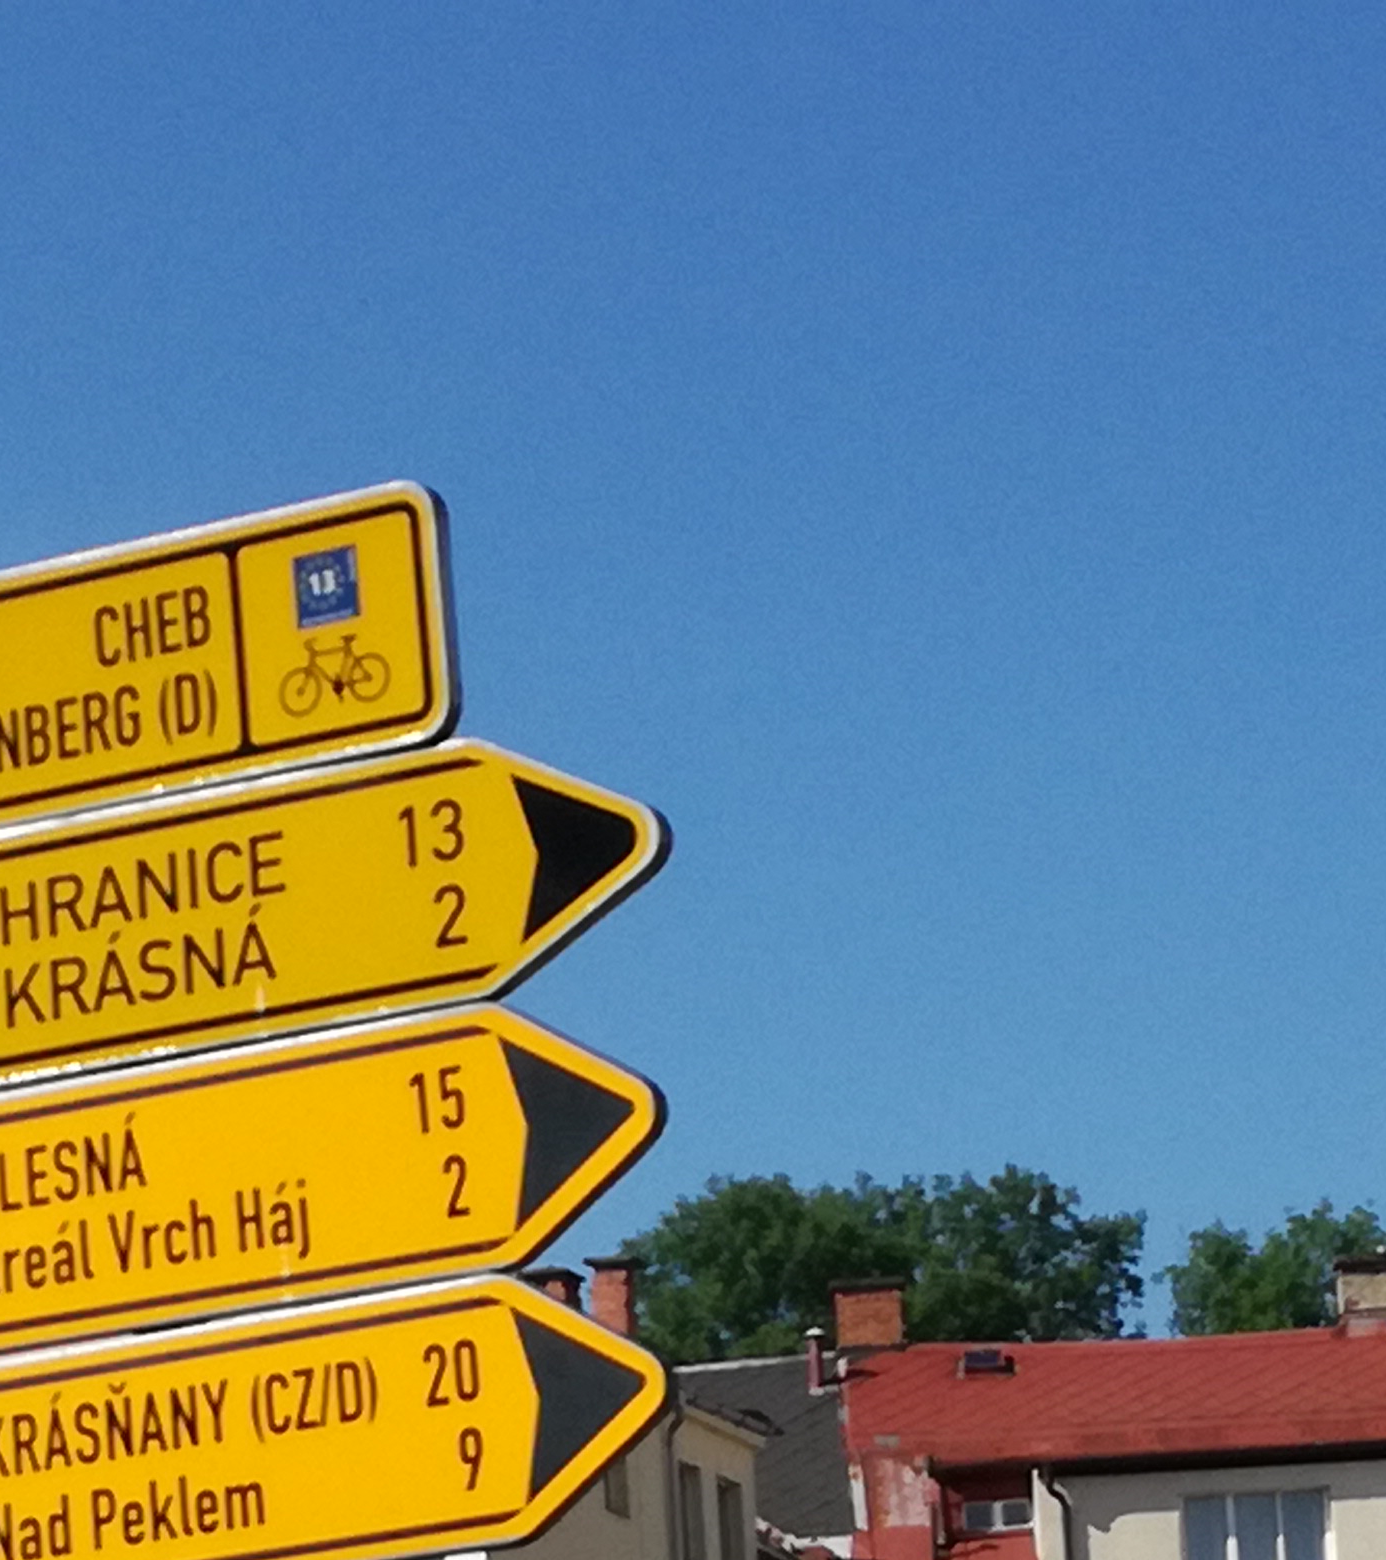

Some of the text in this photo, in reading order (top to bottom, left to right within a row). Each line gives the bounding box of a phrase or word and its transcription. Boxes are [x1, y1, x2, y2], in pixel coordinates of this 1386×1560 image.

[94, 586, 211, 669] CHEB
[159, 671, 218, 744] (D)
[0, 800, 464, 946] HRANICE 13
[4, 884, 468, 1028] KRÁSNÁ 2
[410, 1065, 465, 1133] 15
[108, 1199, 217, 1273] Vrch
[236, 1180, 310, 1259] Háj
[443, 1155, 471, 1219] 2
[252, 1358, 378, 1442] (CZ/D)
[423, 1340, 480, 1407] 20
[93, 1478, 266, 1550] Peklem
[460, 1428, 483, 1491] 9
